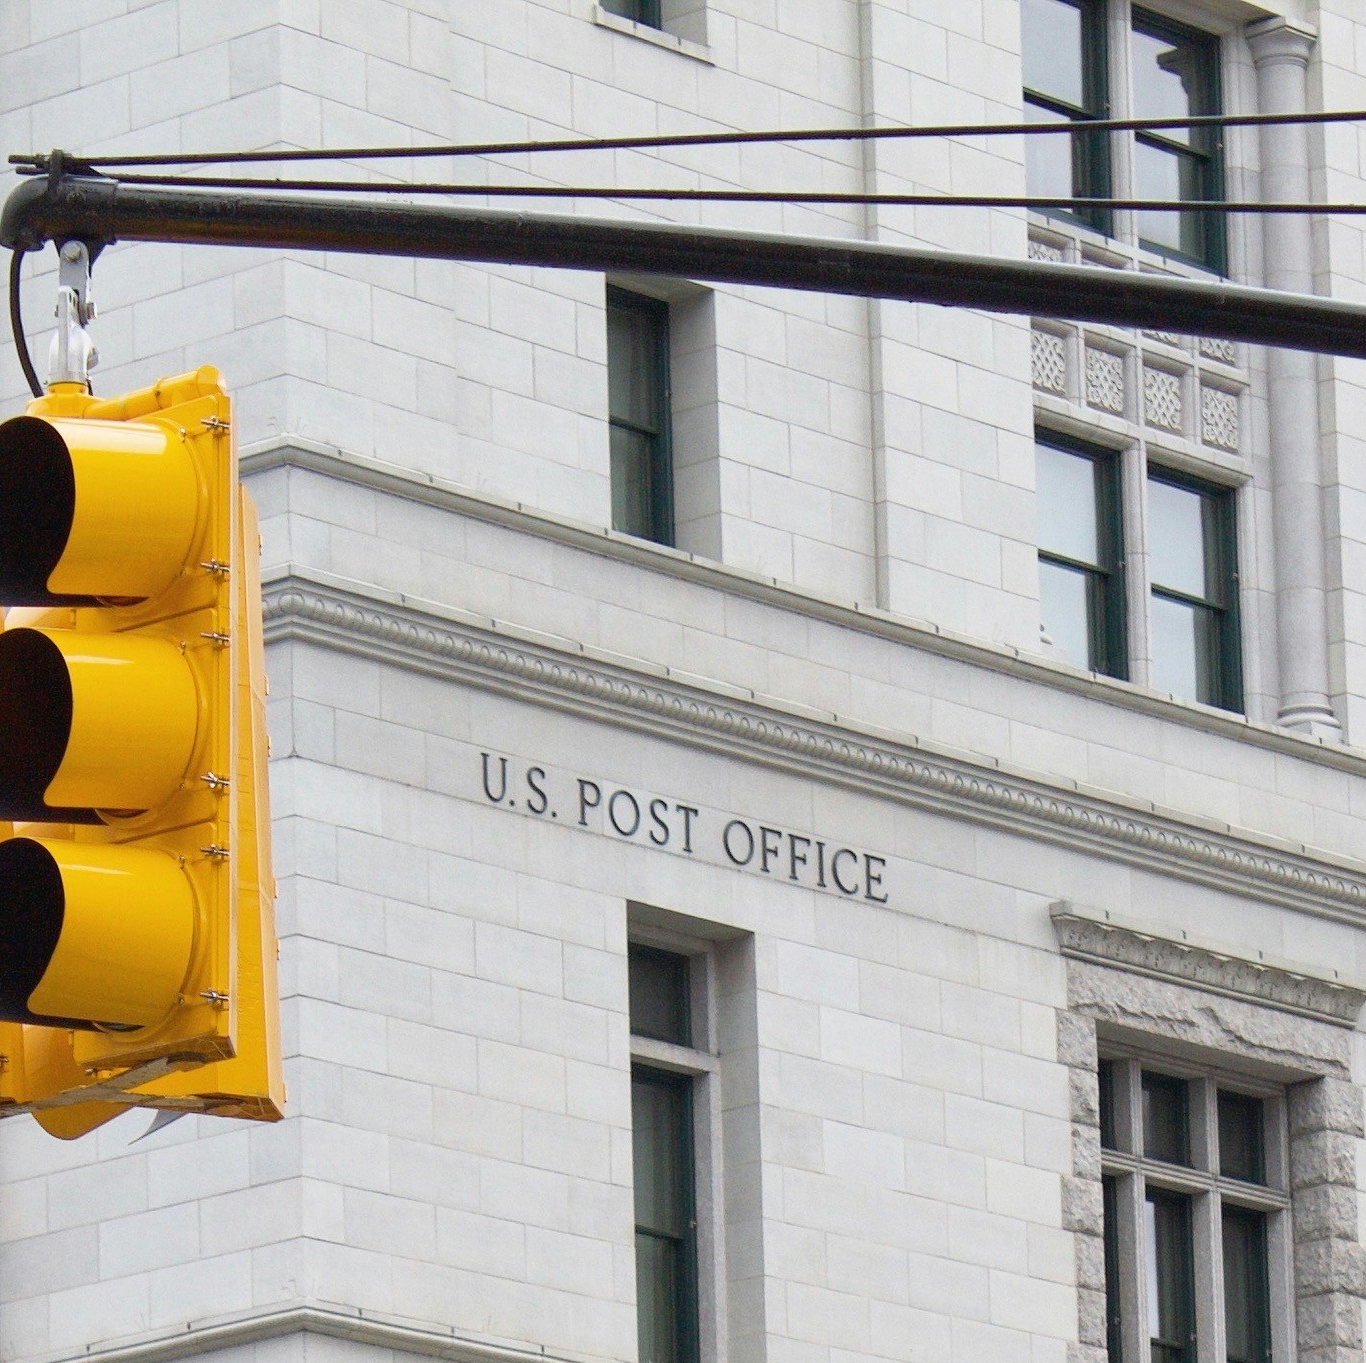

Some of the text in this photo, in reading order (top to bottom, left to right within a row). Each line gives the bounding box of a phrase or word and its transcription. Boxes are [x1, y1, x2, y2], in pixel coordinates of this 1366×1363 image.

[480, 752, 889, 903] U.S. POST OFFICE
